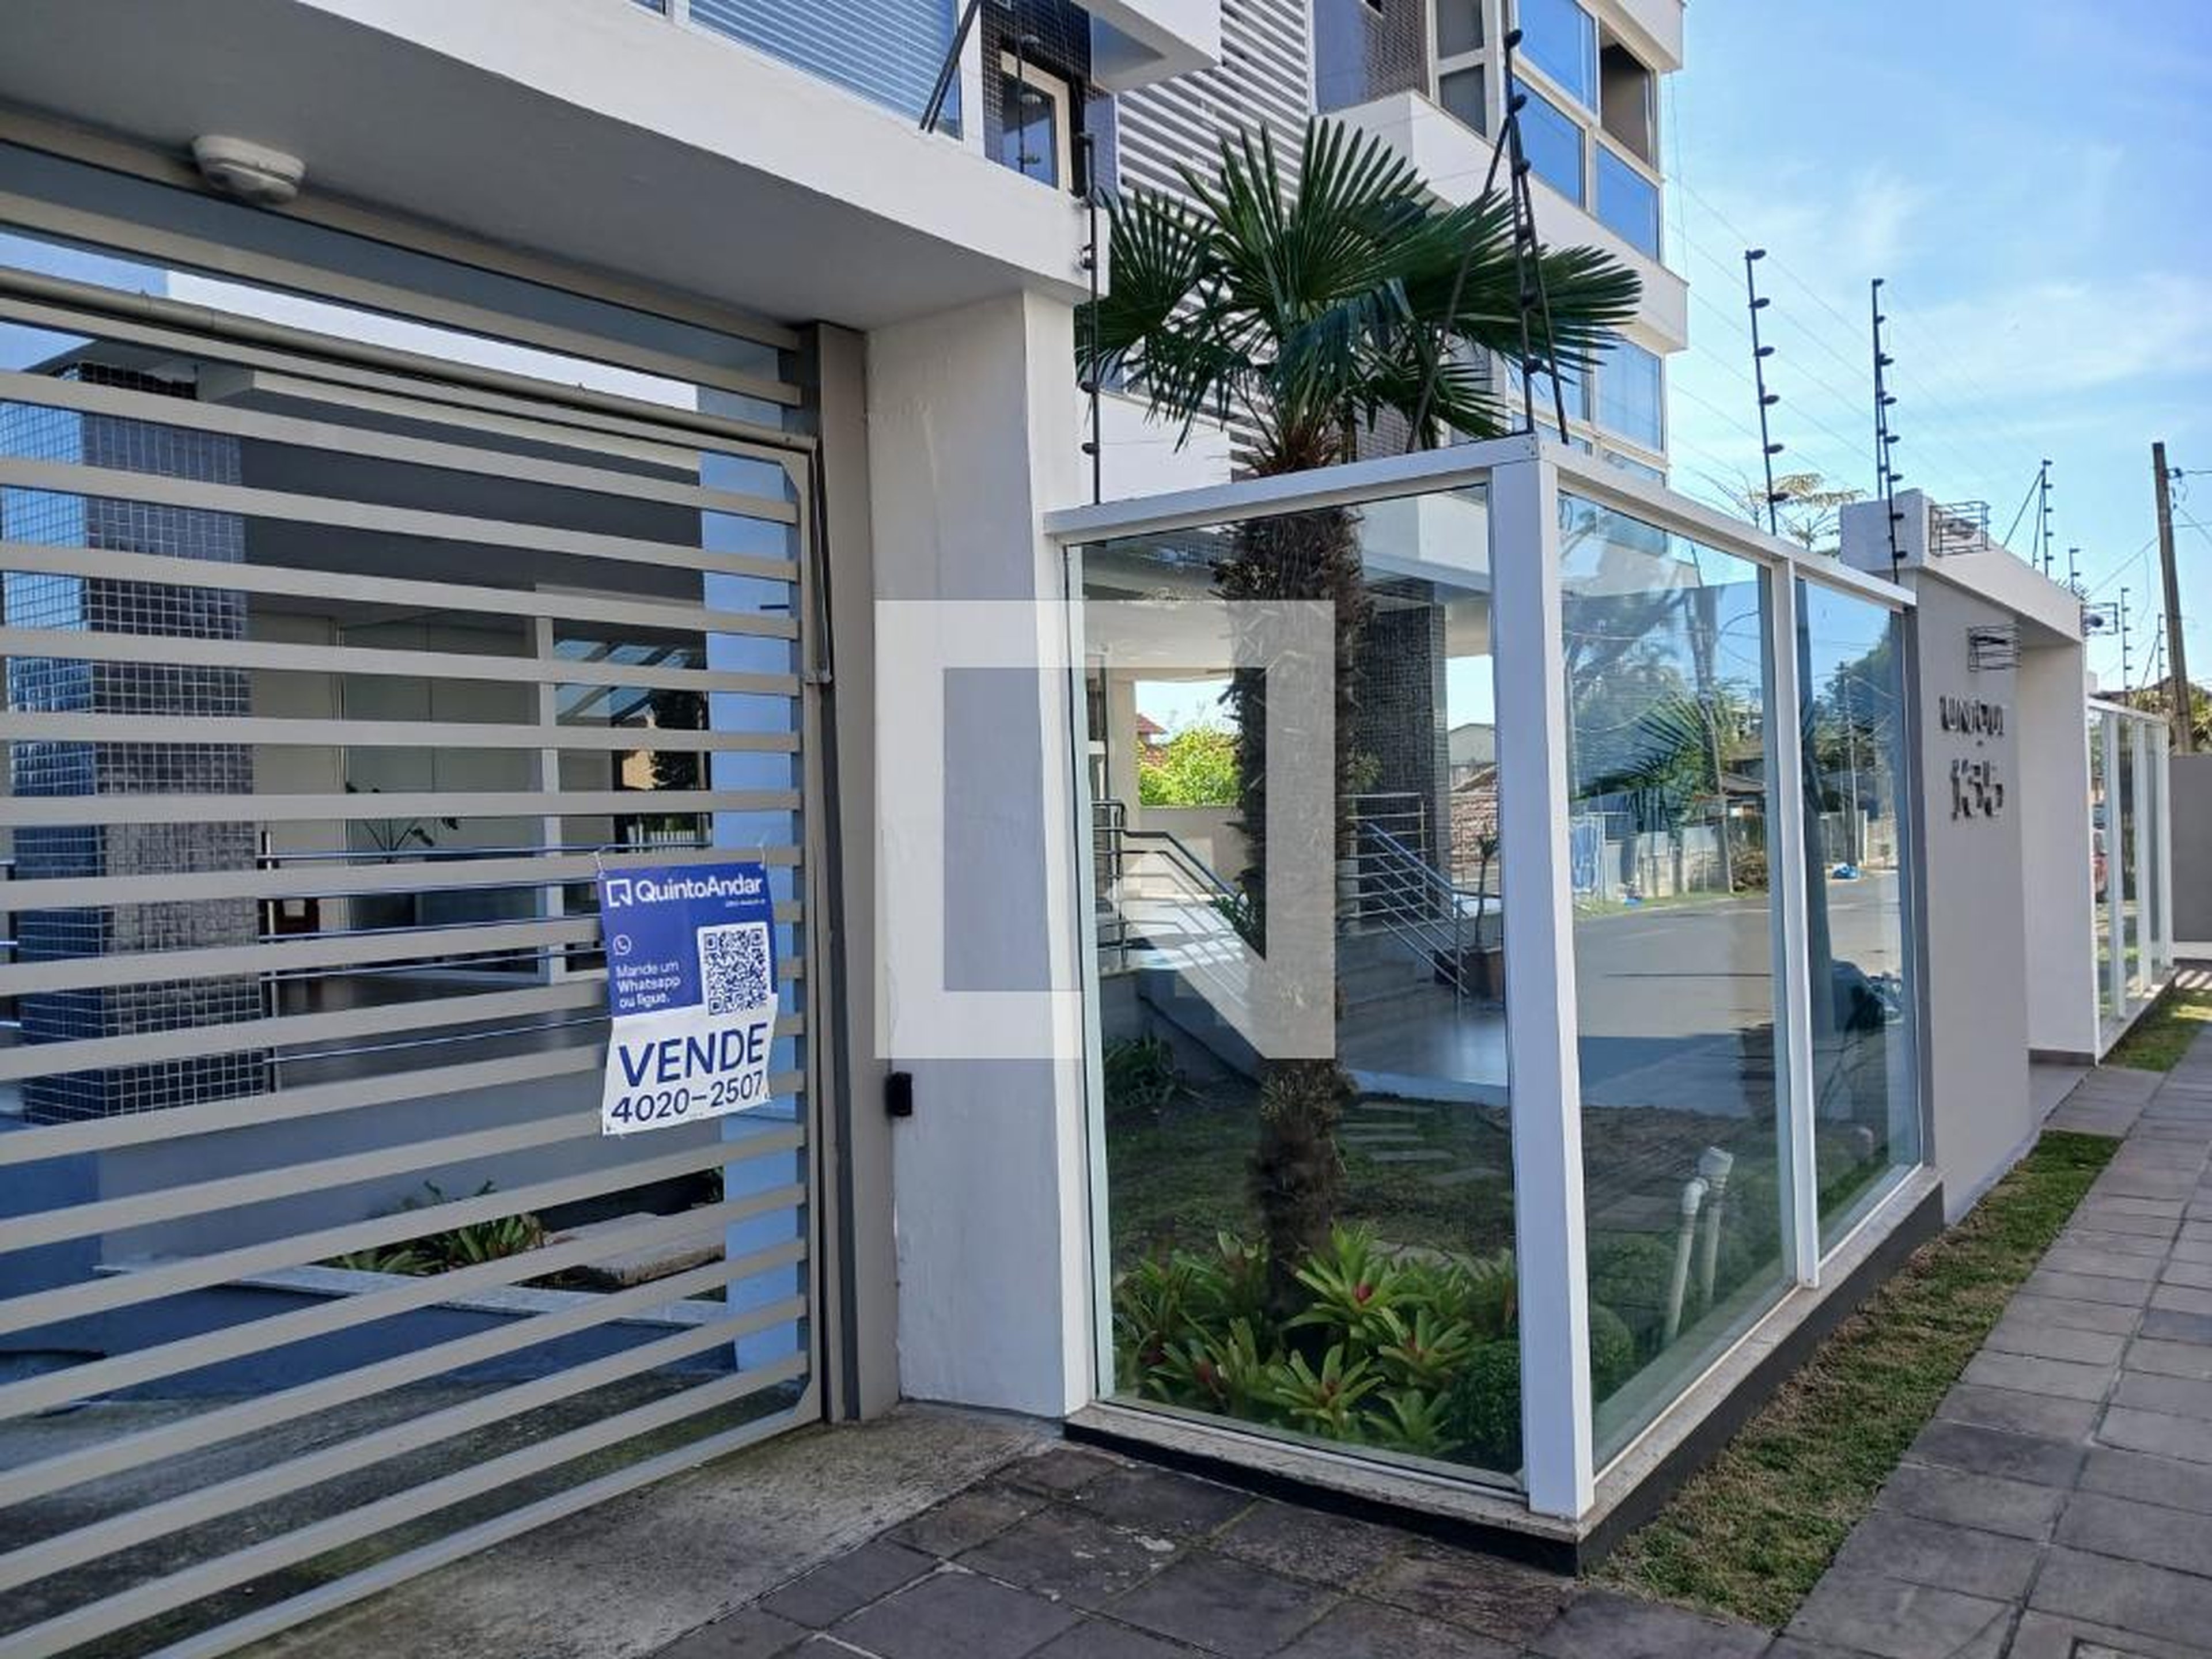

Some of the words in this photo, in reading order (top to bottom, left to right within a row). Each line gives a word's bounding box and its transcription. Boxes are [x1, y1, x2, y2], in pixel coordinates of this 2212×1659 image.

[1951, 759, 2004, 820] 135
[636, 873, 763, 902] QuintoAndar
[616, 962, 658, 978] Mande
[660, 961, 679, 973] um
[619, 997, 635, 1009] ou
[619, 1022, 768, 1088] VENDE
[611, 1070, 764, 1124] 4020-2507
